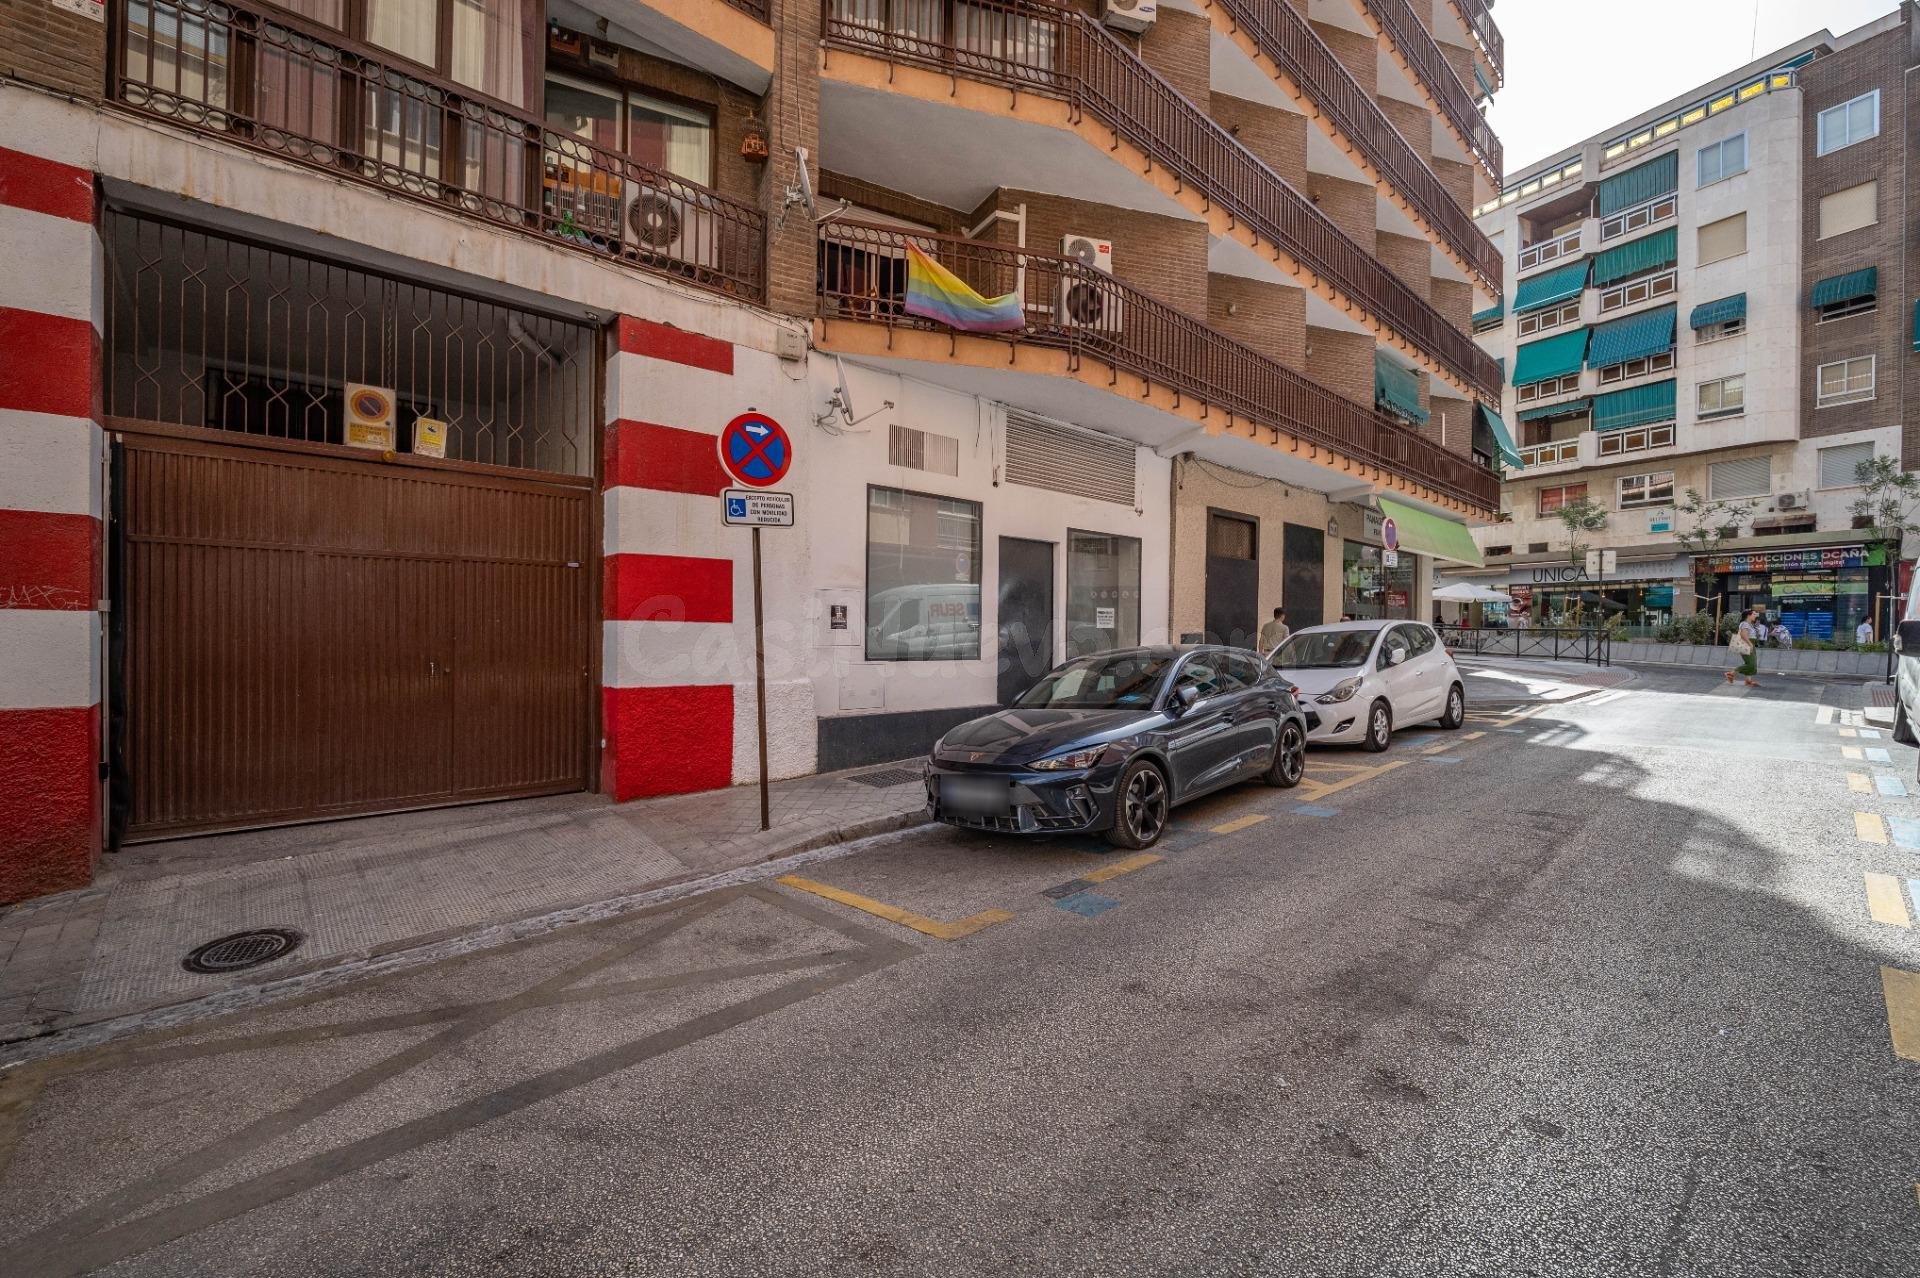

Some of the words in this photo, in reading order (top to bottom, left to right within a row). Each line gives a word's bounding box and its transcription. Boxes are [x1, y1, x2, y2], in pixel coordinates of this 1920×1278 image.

[1708, 551, 1818, 565] REPRODUCCIONES
[1820, 548, 1870, 559] OCAÑA
[1532, 566, 1590, 583] UNICA
